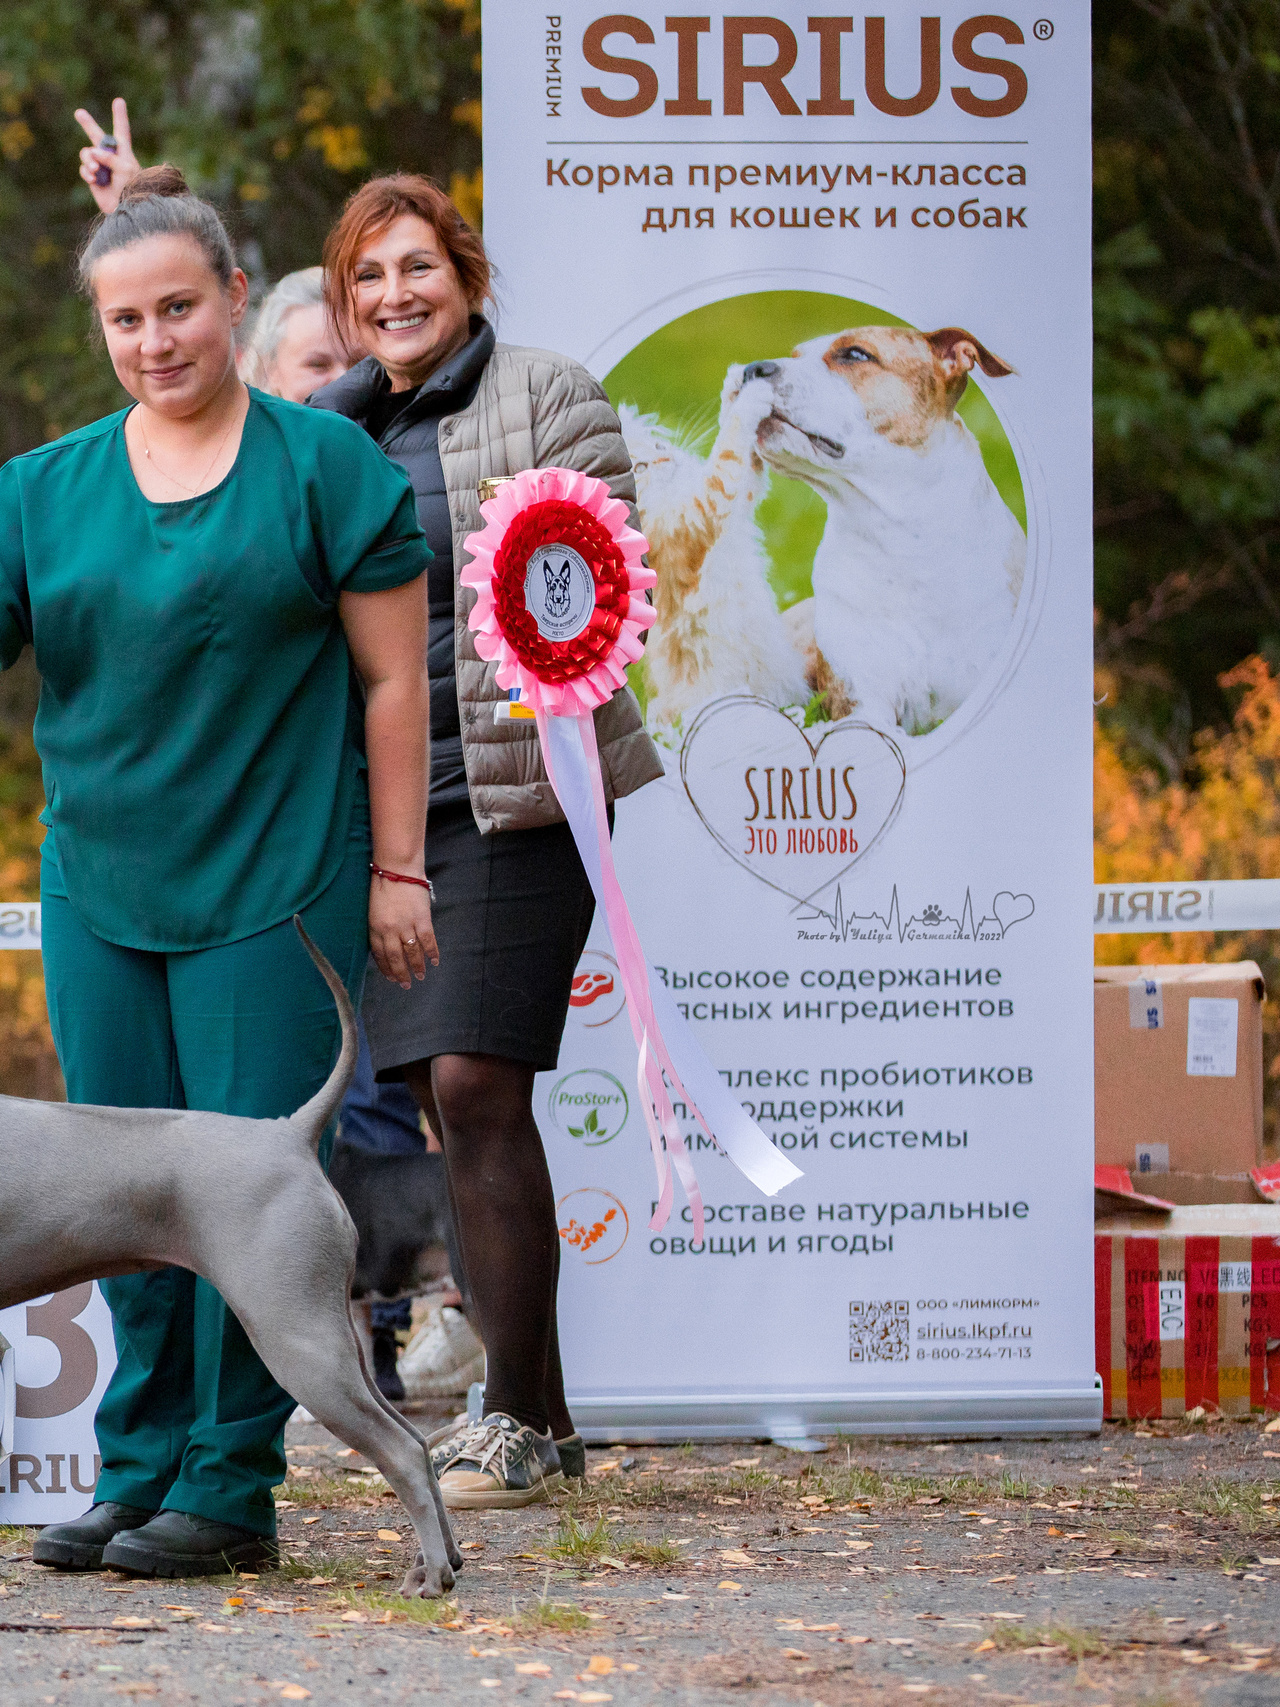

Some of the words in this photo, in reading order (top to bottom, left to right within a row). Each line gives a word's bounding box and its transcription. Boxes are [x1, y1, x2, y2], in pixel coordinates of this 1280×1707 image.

[546, 15, 561, 117] PREMIUM
[546, 159, 673, 193] Корма
[689, 164, 1027, 192] премиум-класса
[641, 207, 714, 233] для
[730, 206, 860, 229] кошек
[875, 207, 896, 228] и
[911, 199, 1028, 229] собак
[744, 766, 858, 821] SIRIUS
[801, 966, 1002, 991] содержание
[677, 1001, 773, 1020] ясных
[783, 998, 1014, 1023] ингредиентов
[820, 1061, 1033, 1090] пробиотиков
[740, 1100, 904, 1123] оддержки
[830, 1128, 968, 1150] системы
[818, 1200, 1030, 1227] натуральные
[649, 1234, 755, 1257] овощи
[769, 1235, 785, 1253] и
[797, 1233, 893, 1256] ягоды
[1160, 1288, 1184, 1331] EAC
[916, 1322, 1032, 1340] sirius.lkpf.ru
[916, 1347, 1032, 1360] 8-800-234-71-13
